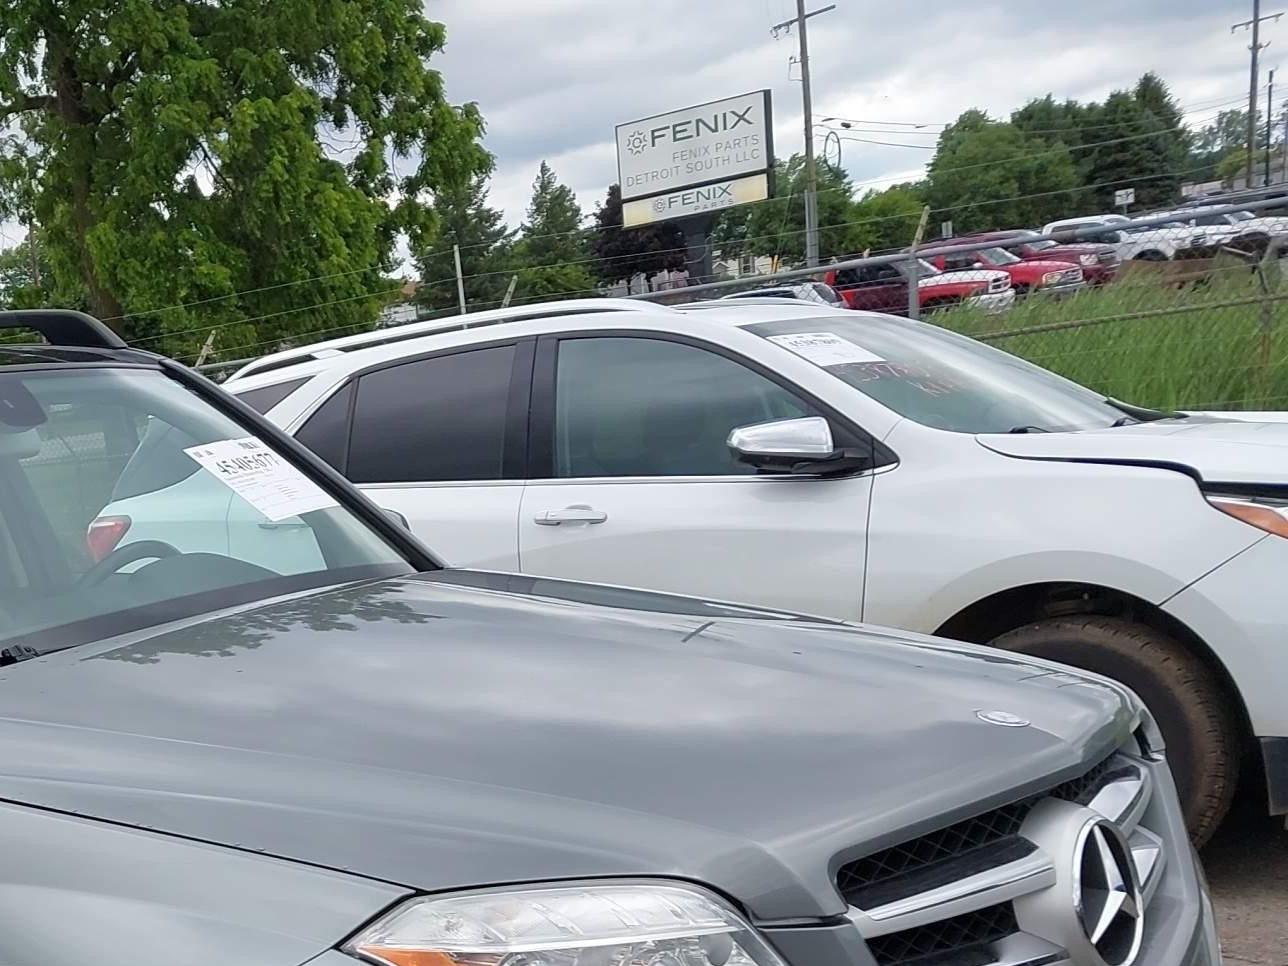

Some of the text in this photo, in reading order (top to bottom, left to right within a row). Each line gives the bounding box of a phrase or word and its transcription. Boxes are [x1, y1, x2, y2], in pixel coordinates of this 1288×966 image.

[650, 106, 754, 147] FENIX
[672, 134, 760, 162] FENIX PARTS
[626, 148, 760, 187] DETROIT SOUTH LLC
[668, 183, 733, 208] FENIX
[694, 198, 734, 211] PARTS
[215, 452, 280, 475] 45405677
